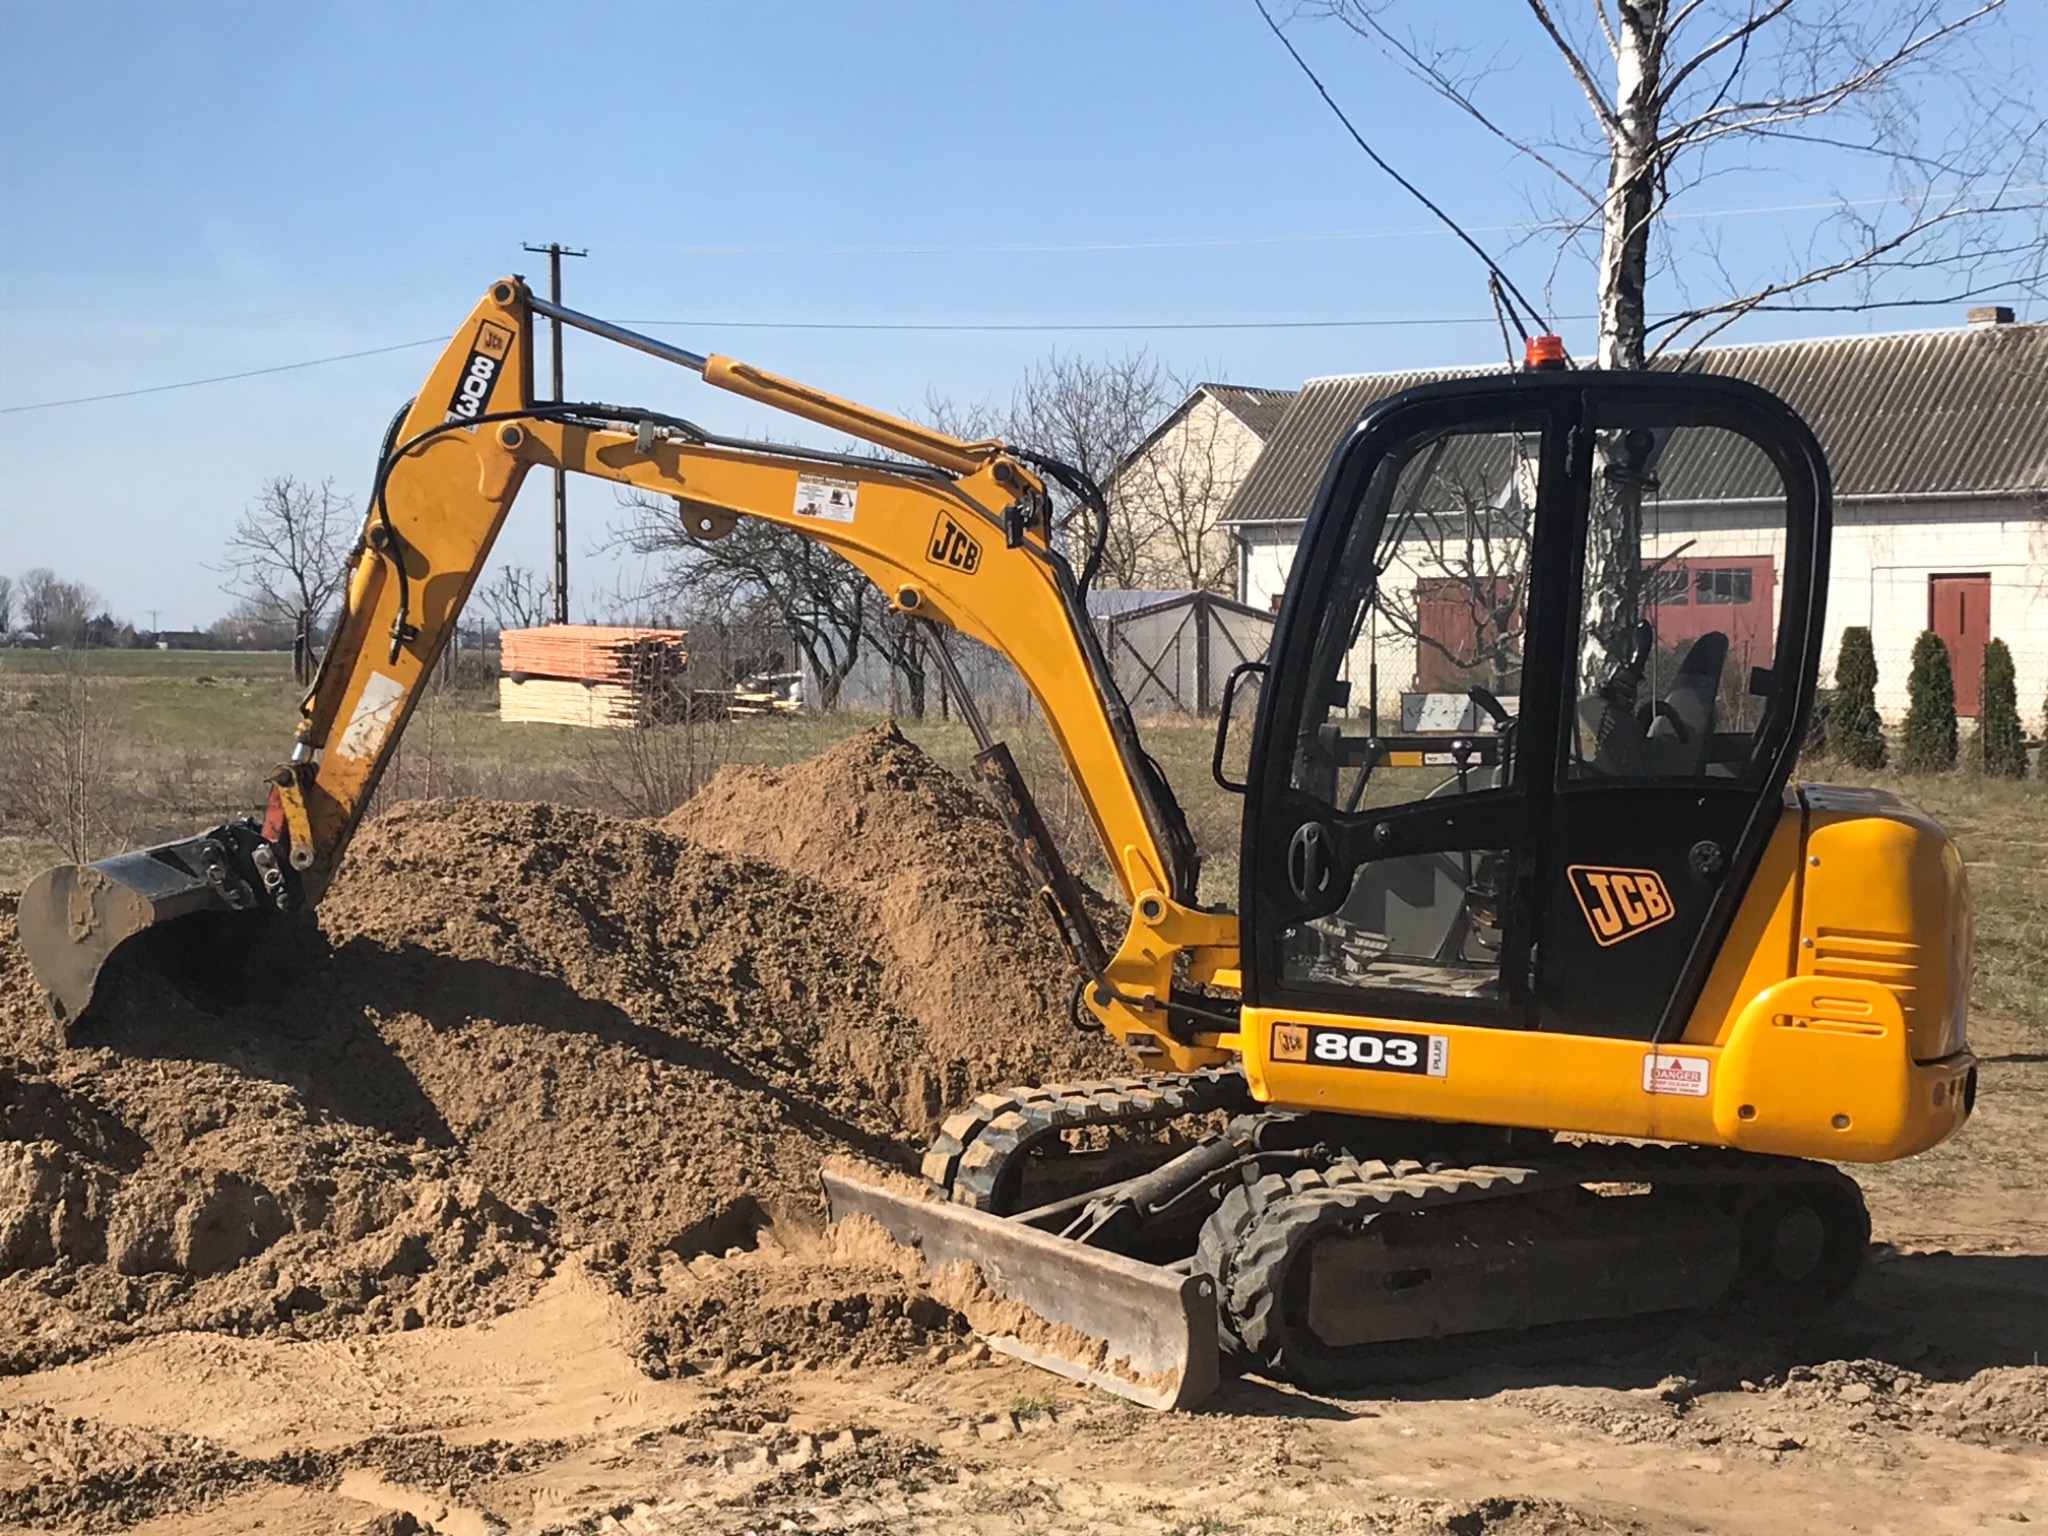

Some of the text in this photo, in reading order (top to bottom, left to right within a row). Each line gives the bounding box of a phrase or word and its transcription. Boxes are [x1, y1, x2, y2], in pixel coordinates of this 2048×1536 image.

[455, 356, 495, 418] 803
[931, 520, 978, 571] JCB
[1585, 873, 1667, 936] JCB
[1283, 1034, 1303, 1051] JCB
[1314, 1032, 1418, 1067] 803
[1433, 1040, 1442, 1070] PLUS
[1653, 1070, 1699, 1081] DANGER
